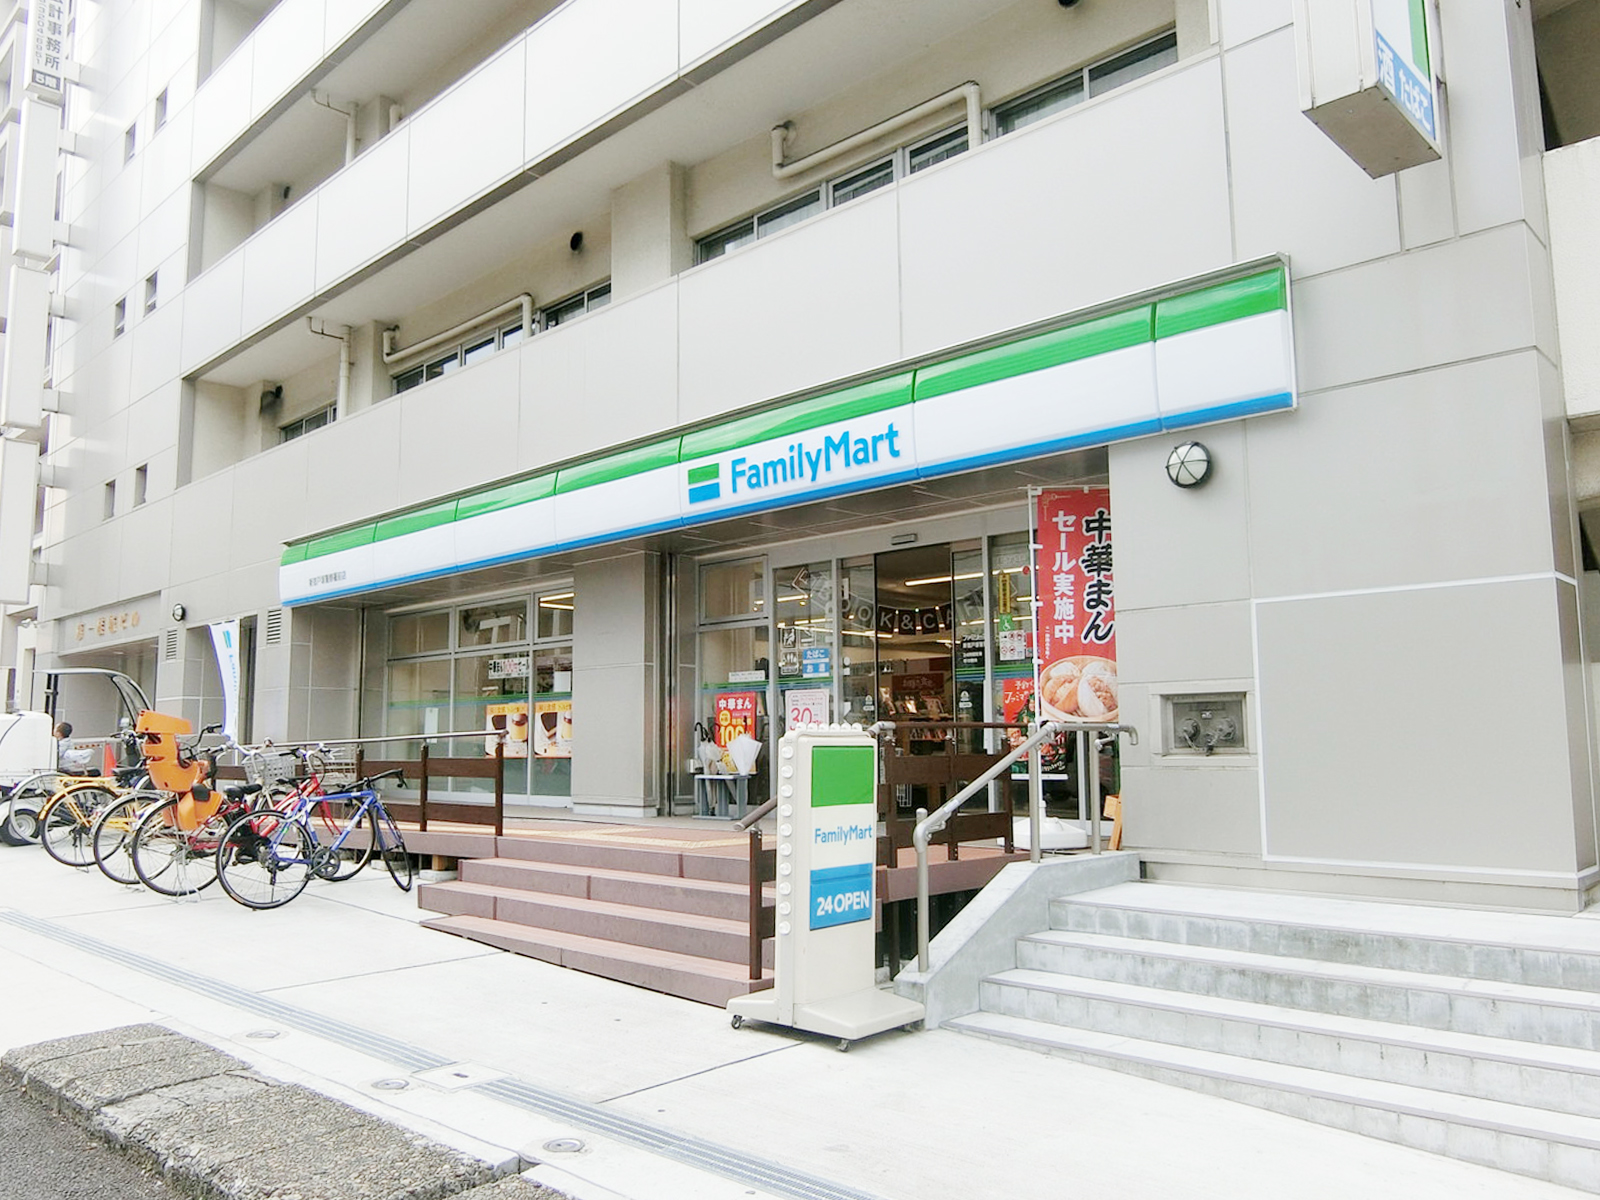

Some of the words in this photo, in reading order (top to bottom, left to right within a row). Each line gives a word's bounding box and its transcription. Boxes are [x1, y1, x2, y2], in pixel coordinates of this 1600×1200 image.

[1377, 36, 1396, 96] 酒
[1398, 69, 1432, 131] たばこ
[731, 422, 900, 494] FamilyMart
[1052, 510, 1076, 644] セール実施中
[1080, 509, 1114, 644] 中華まん
[806, 649, 825, 658] たばこ
[718, 697, 752, 710] 中華まん
[815, 824, 872, 845] FamilyMart
